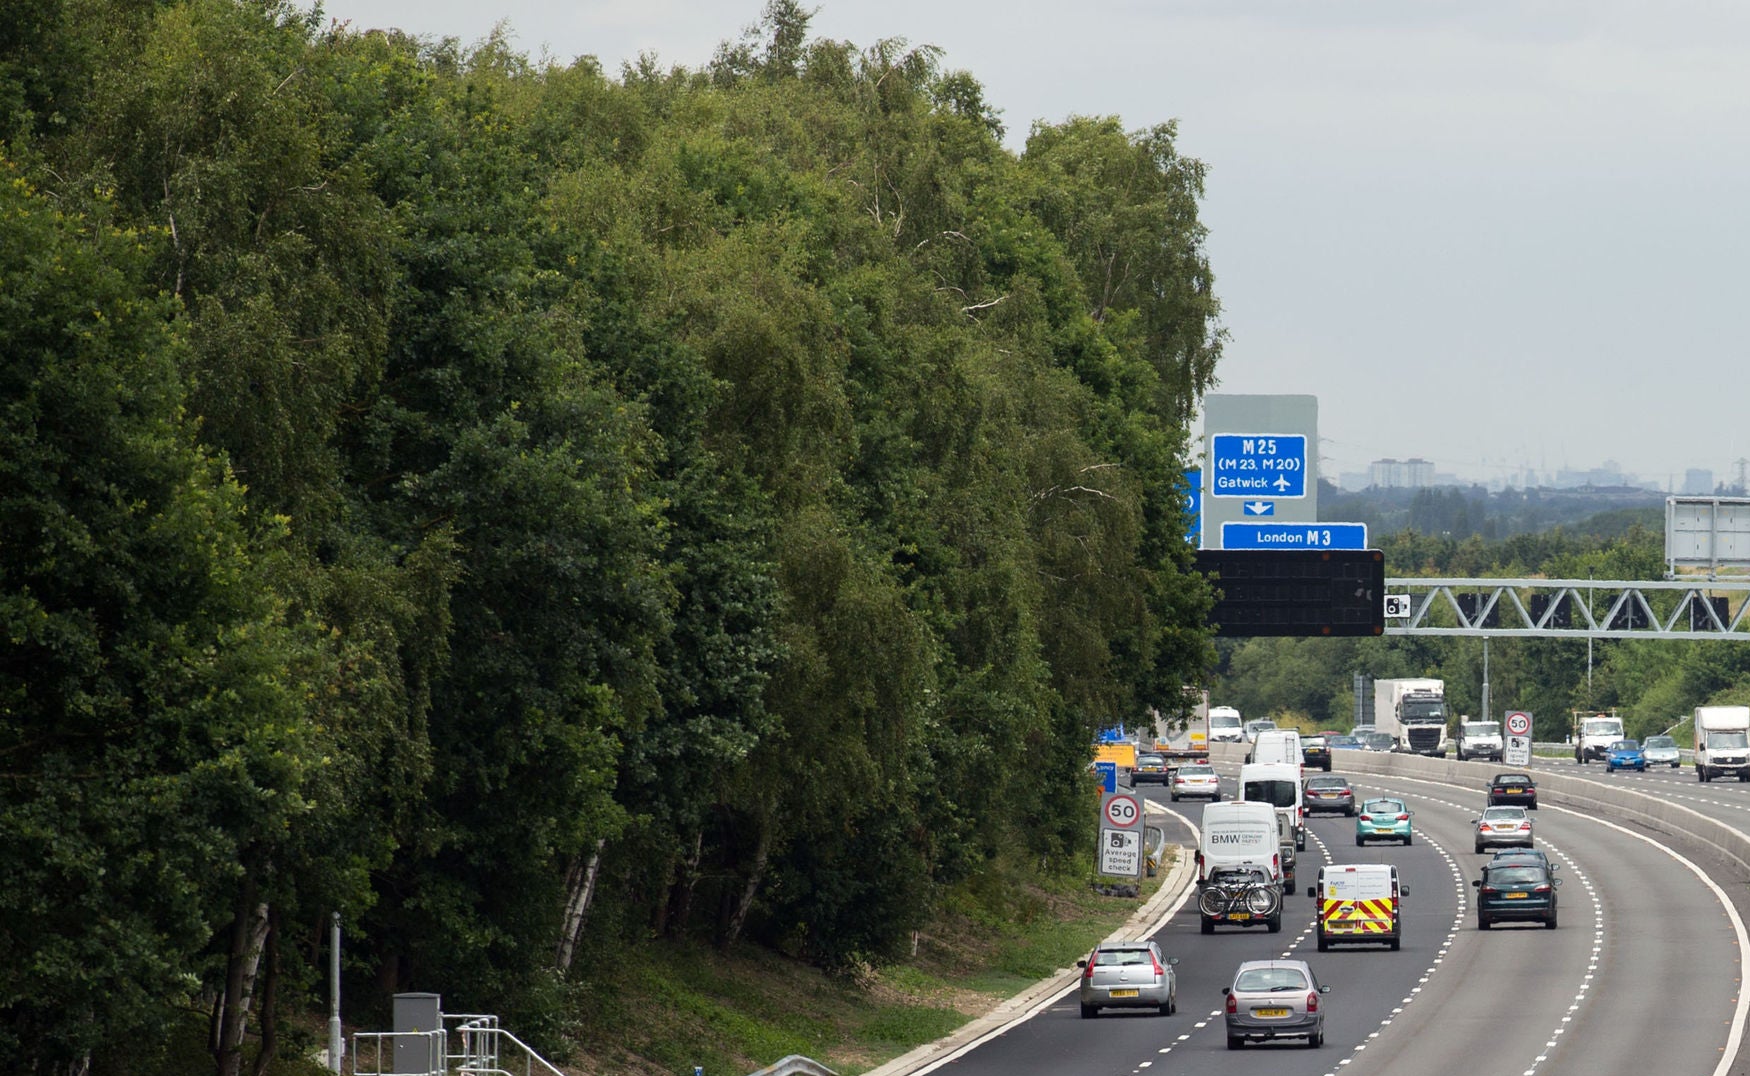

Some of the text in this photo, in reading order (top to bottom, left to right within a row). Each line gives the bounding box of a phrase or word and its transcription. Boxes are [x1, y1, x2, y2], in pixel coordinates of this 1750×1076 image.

[1243, 440, 1277, 455] M 25
[1218, 458, 1300, 471] (M 23, M 20)
[1218, 477, 1268, 489] Gatwick
[1257, 530, 1331, 545] London M 3
[1511, 719, 1526, 728] 50
[1111, 805, 1135, 818] 50
[1211, 834, 1240, 844] BMW
[1105, 849, 1136, 858] Average
[1109, 857, 1132, 865] speed
[1108, 864, 1131, 872] check
